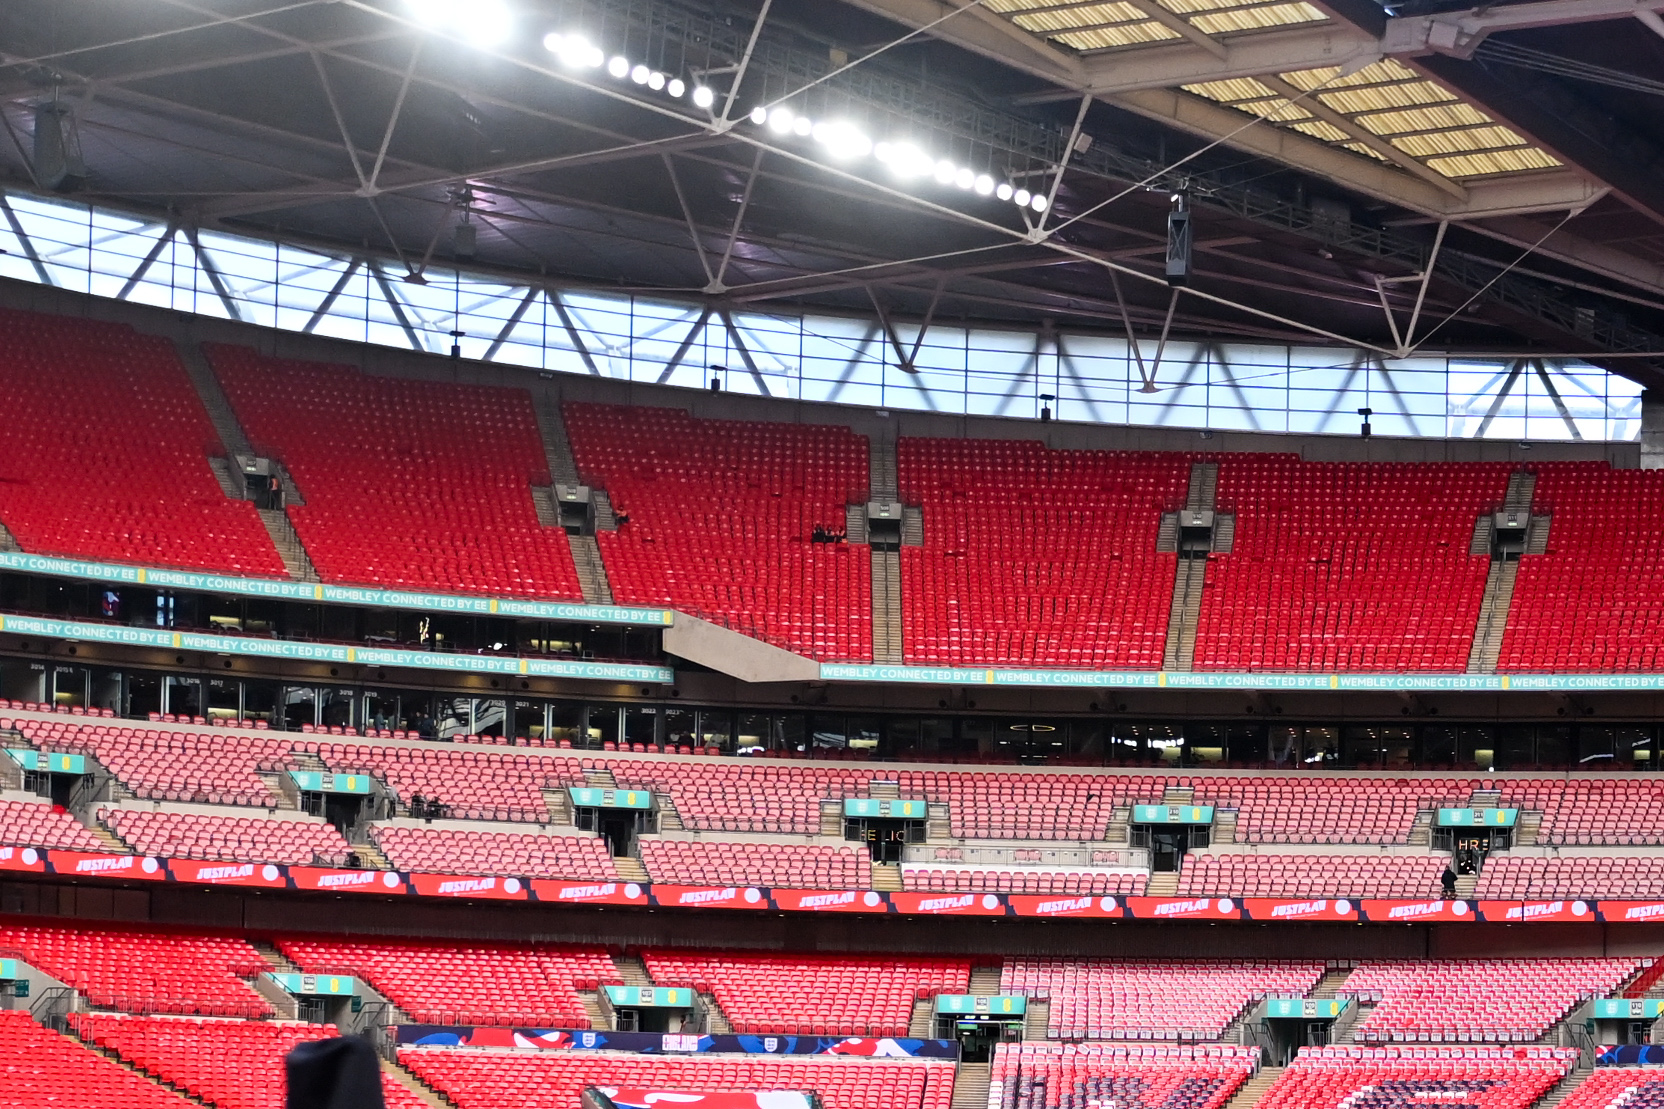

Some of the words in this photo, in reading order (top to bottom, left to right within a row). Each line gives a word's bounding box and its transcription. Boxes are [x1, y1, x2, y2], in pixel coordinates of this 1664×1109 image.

[29, 558, 102, 576] CONNECTED
[103, 566, 119, 578] BY
[121, 568, 135, 580] EE
[148, 572, 204, 586] WEMBLEY
[206, 577, 280, 594] CONNECTED
[281, 584, 297, 595] BY
[298, 586, 312, 597] EE
[325, 588, 381, 602] WEMBLEY
[383, 593, 456, 608] CONNECTED
[457, 599, 473, 609] BY
[474, 600, 487, 610] EE
[500, 602, 555, 615] WEMBLEY
[557, 606, 629, 620] CONNECTED
[630, 610, 646, 620] BY
[647, 611, 661, 622] EE
[7, 620, 62, 633] WEMBLEY
[64, 625, 138, 641] CONNECTED
[139, 632, 155, 642] BY
[157, 633, 170, 644] EE
[183, 636, 239, 650] WEMBLEY
[240, 641, 313, 656] CONNECTED
[314, 647, 330, 657] BY
[331, 648, 345, 659] EE
[357, 651, 412, 663] WEMBLEY
[414, 655, 486, 669] CONNECTED
[487, 660, 502, 670] BY
[504, 661, 517, 671] EE
[529, 663, 584, 675] WEMBLEY
[658, 671, 671, 681] EE
[822, 666, 878, 678] WEMBLEY
[879, 668, 952, 680] CONNECTED
[953, 671, 969, 681] BY
[970, 671, 983, 681] EE
[996, 672, 1051, 683] WEMBLEY
[1053, 673, 1125, 684] CONNECTED
[1126, 674, 1141, 684] BY
[1143, 675, 1156, 685] EE
[1169, 675, 1223, 686] WEMBLEY
[1225, 676, 1296, 687] CONNECTED
[1297, 677, 1313, 687] BY
[1314, 677, 1328, 687] EE
[1340, 677, 1395, 687] WEMBLEY
[1397, 677, 1468, 687] CONNECTED
[1469, 678, 1484, 687] BY
[1486, 678, 1499, 687] EE
[1512, 677, 1566, 687] WEMBLEY
[1568, 677, 1639, 687] CONNECTED
[1641, 677, 1656, 687] BY
[76, 856, 134, 872] JUSTPLAY
[197, 864, 254, 880] JUSTPLAY
[317, 871, 376, 887] JUSTPLAY
[438, 878, 496, 894] JUSTPLAY
[559, 883, 617, 900] JUSTPLAY
[679, 888, 736, 904] JUSTPLAY
[799, 891, 856, 908] JUSTPLAY
[918, 895, 975, 912] JUSTPLAY
[1036, 897, 1092, 914] JUSTPLAY
[1154, 899, 1210, 916] JUSTPLAY
[1271, 900, 1326, 917] JUSTPLAY
[1388, 901, 1444, 918] JUSTPLAY
[1506, 901, 1563, 919] JUSTPLAY
